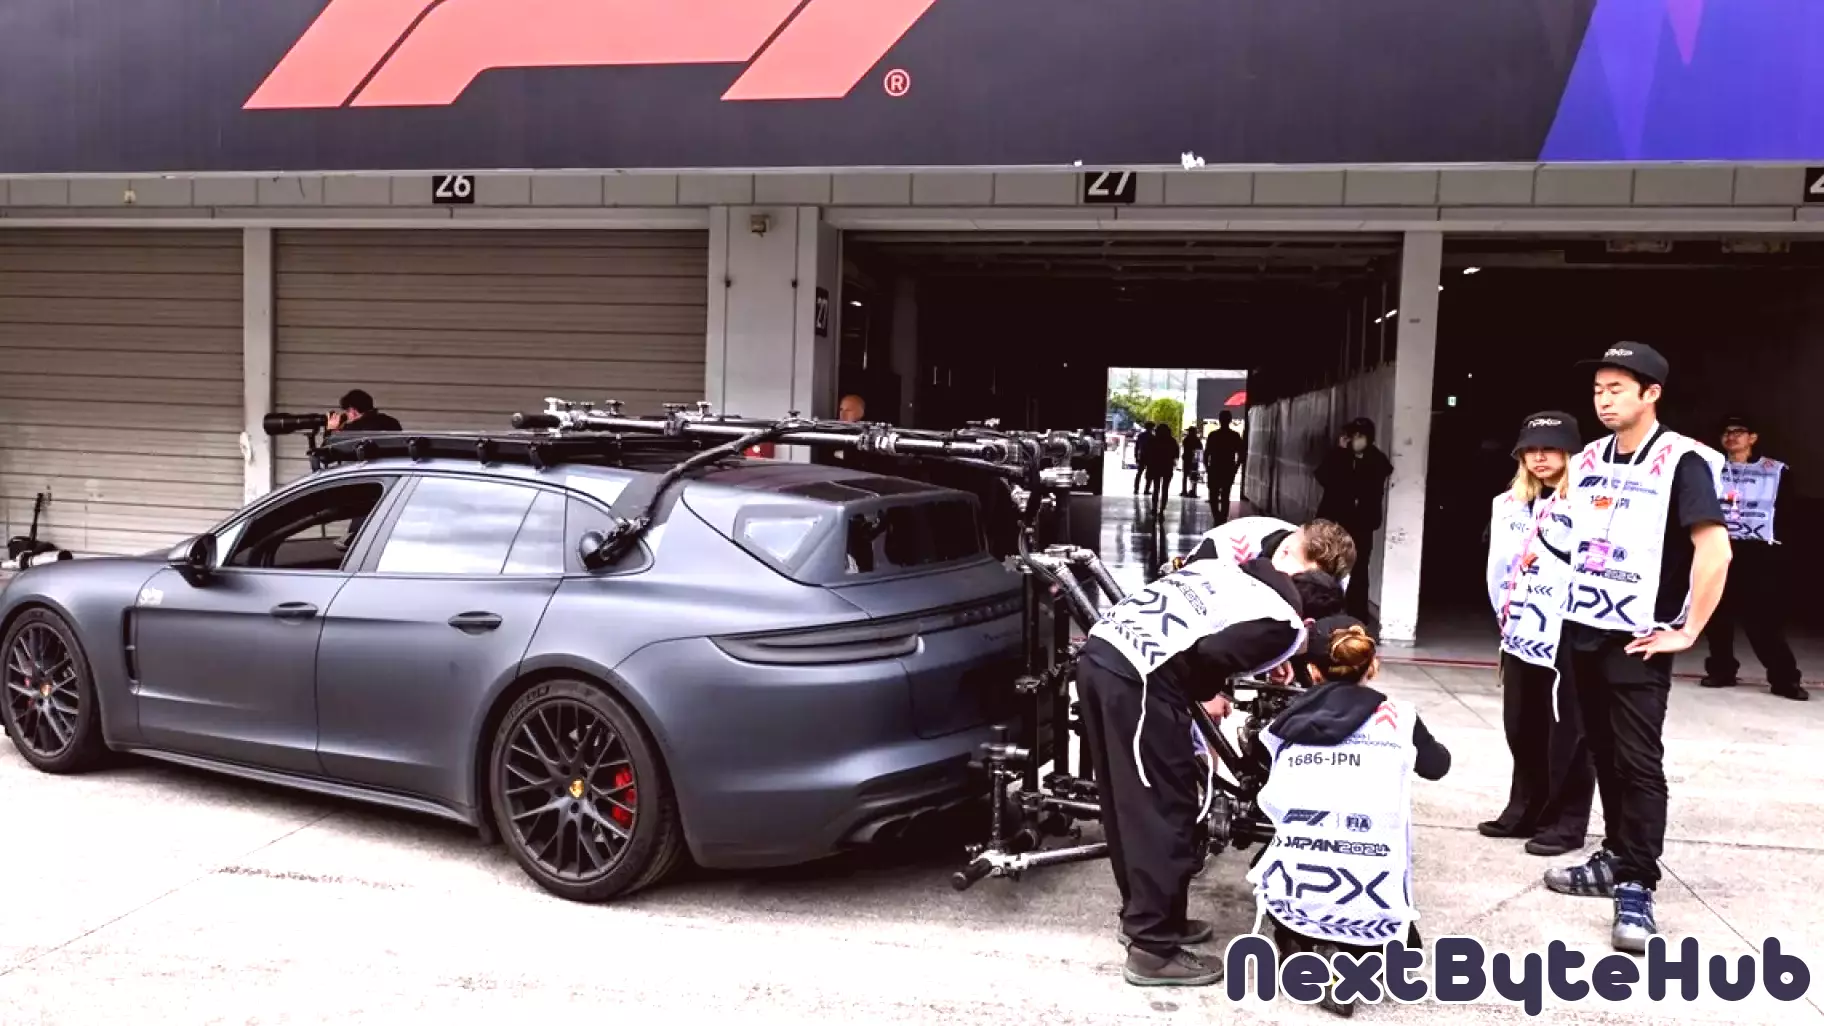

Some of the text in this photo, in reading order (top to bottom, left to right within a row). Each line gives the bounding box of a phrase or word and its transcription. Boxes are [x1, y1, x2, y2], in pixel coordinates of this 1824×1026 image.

[436, 174, 471, 198] 26
[1087, 171, 1131, 196] 27
[1288, 751, 1361, 767] 1686-JPN
